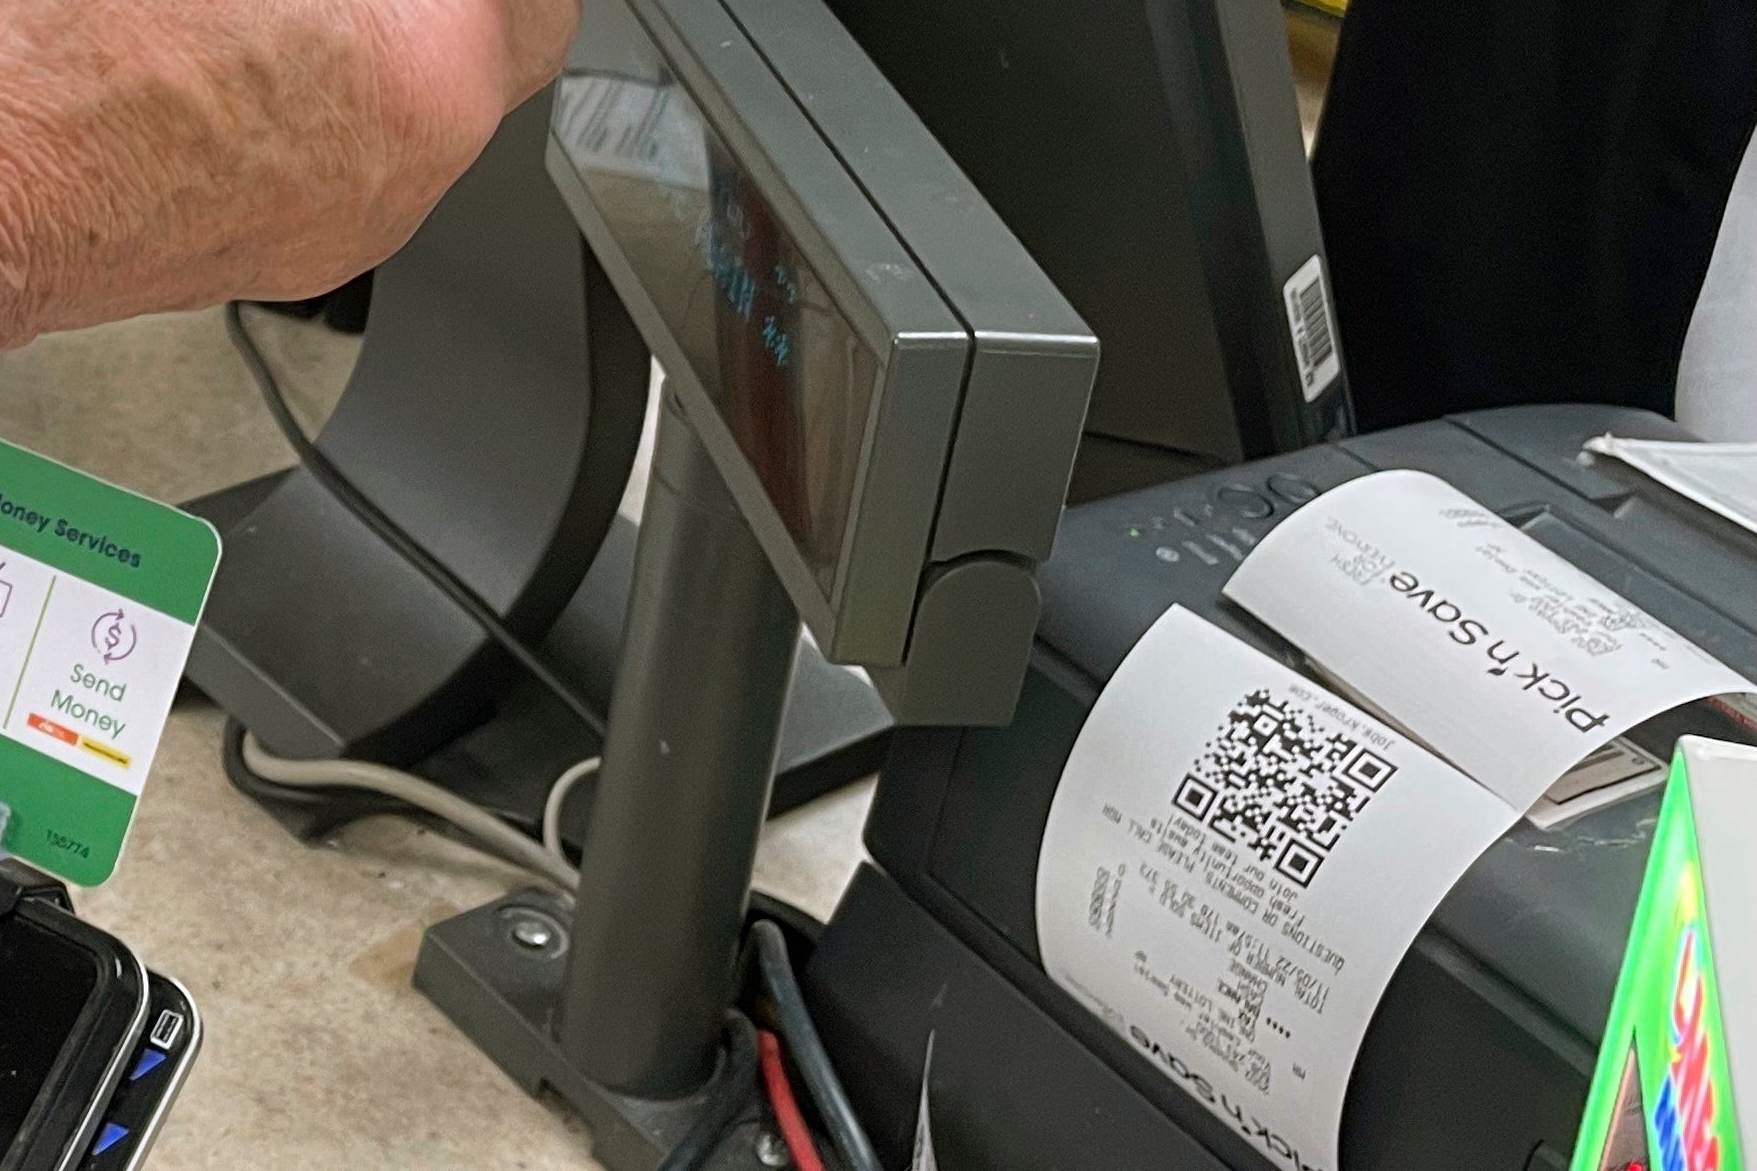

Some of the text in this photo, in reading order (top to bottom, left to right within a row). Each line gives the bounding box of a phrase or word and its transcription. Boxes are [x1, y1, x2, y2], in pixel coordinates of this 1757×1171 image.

[54, 518, 142, 569] Services
[1389, 570, 1490, 646] Save
[70, 663, 127, 703] Send
[1514, 661, 1611, 734] Pick
[51, 689, 126, 740] Money
[1280, 921, 1346, 975] QUESTIONS
